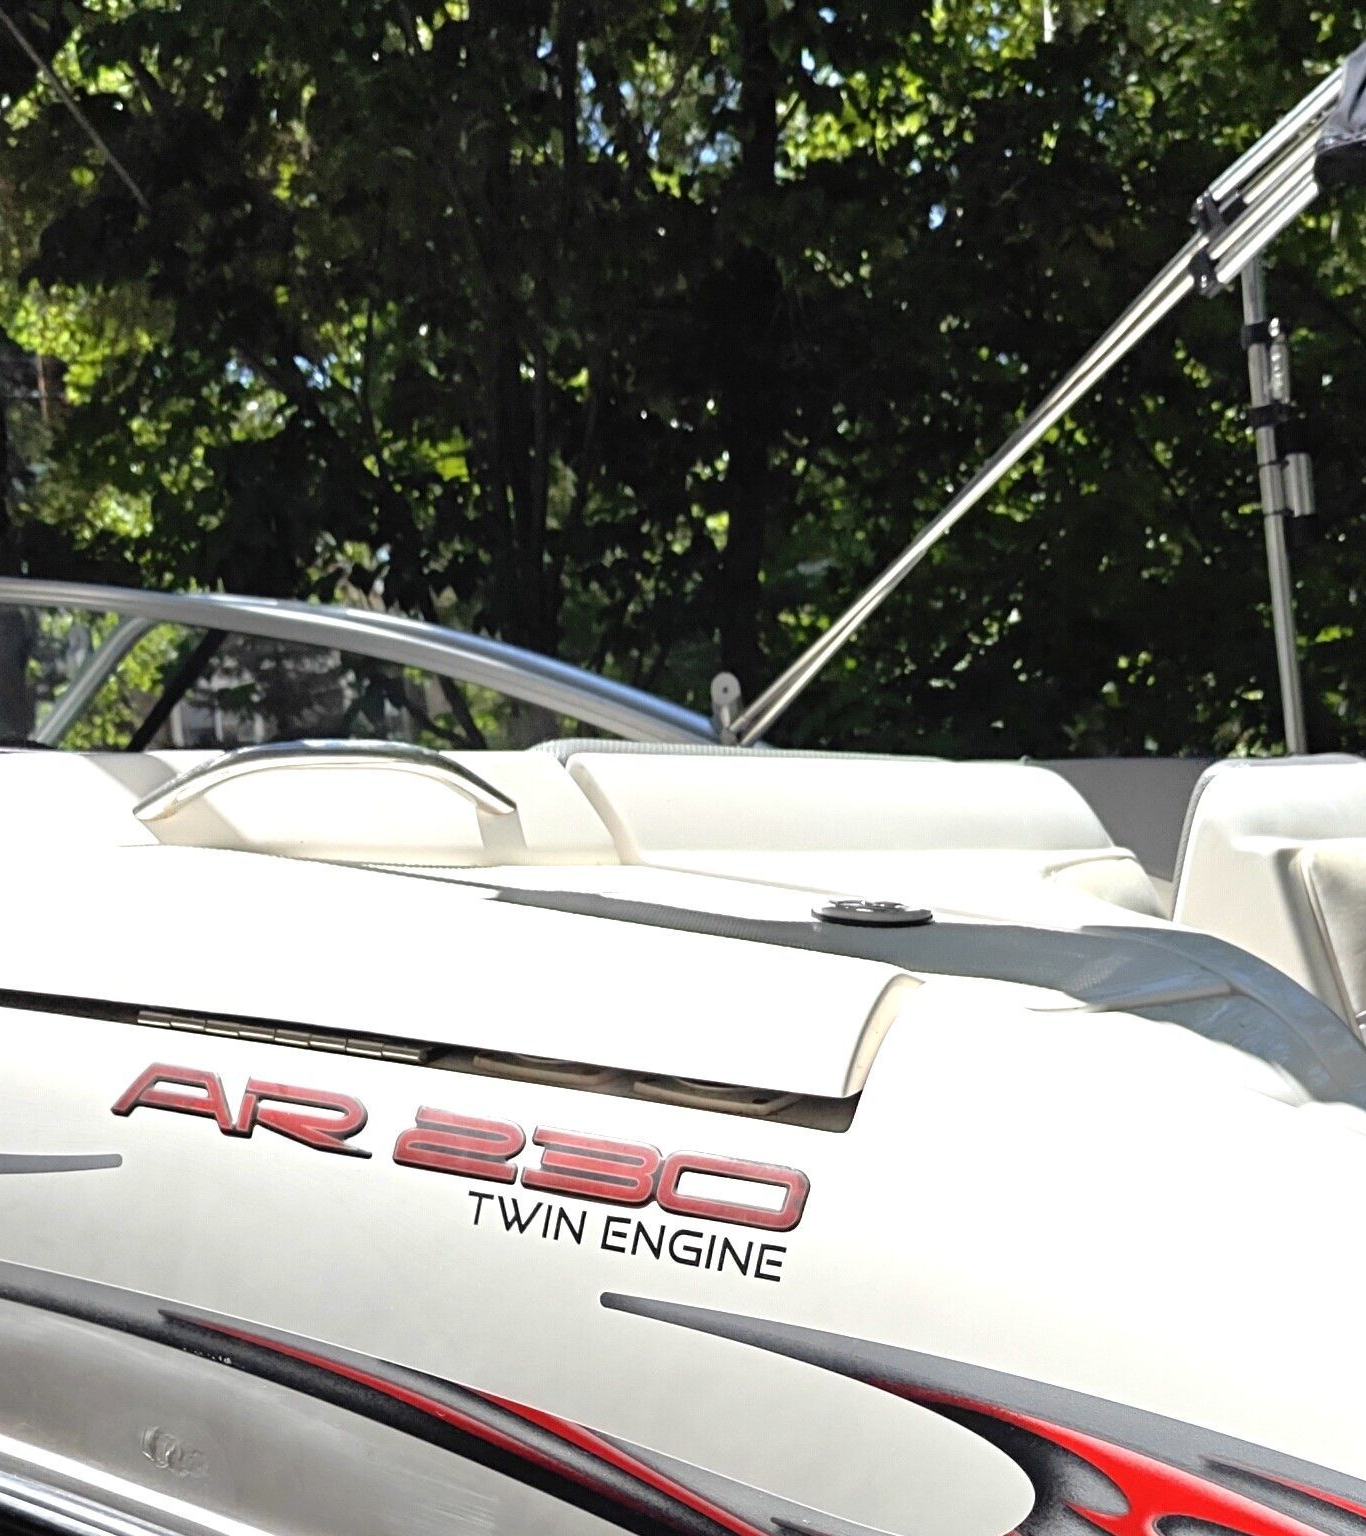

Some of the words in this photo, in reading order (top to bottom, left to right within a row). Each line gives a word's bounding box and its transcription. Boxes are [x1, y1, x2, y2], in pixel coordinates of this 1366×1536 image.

[110, 1061, 373, 1160] AR
[391, 1104, 811, 1234] 230
[469, 1190, 587, 1246] TWIN
[602, 1216, 788, 1283] ENGINE
